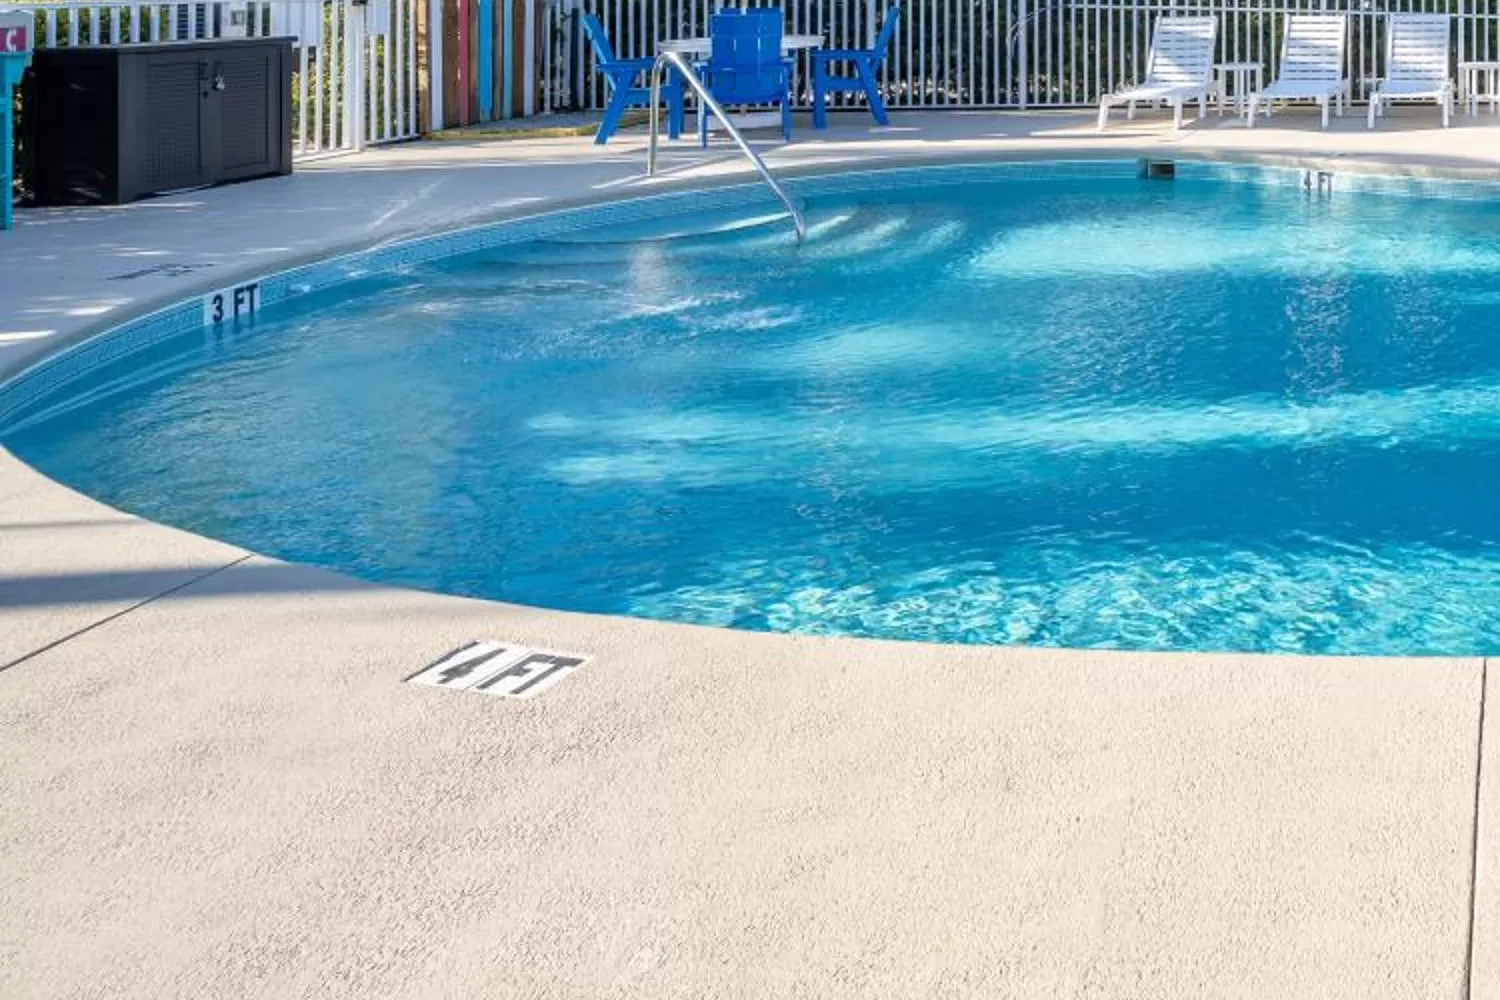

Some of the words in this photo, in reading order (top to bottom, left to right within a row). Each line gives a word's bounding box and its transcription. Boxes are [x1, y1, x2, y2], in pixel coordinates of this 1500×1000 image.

[1303, 170, 1312, 191] 4
[1317, 171, 1334, 192] FT
[212, 293, 224, 323] 3
[233, 284, 258, 317] FT
[436, 649, 508, 685] 4
[475, 653, 586, 695] FT
